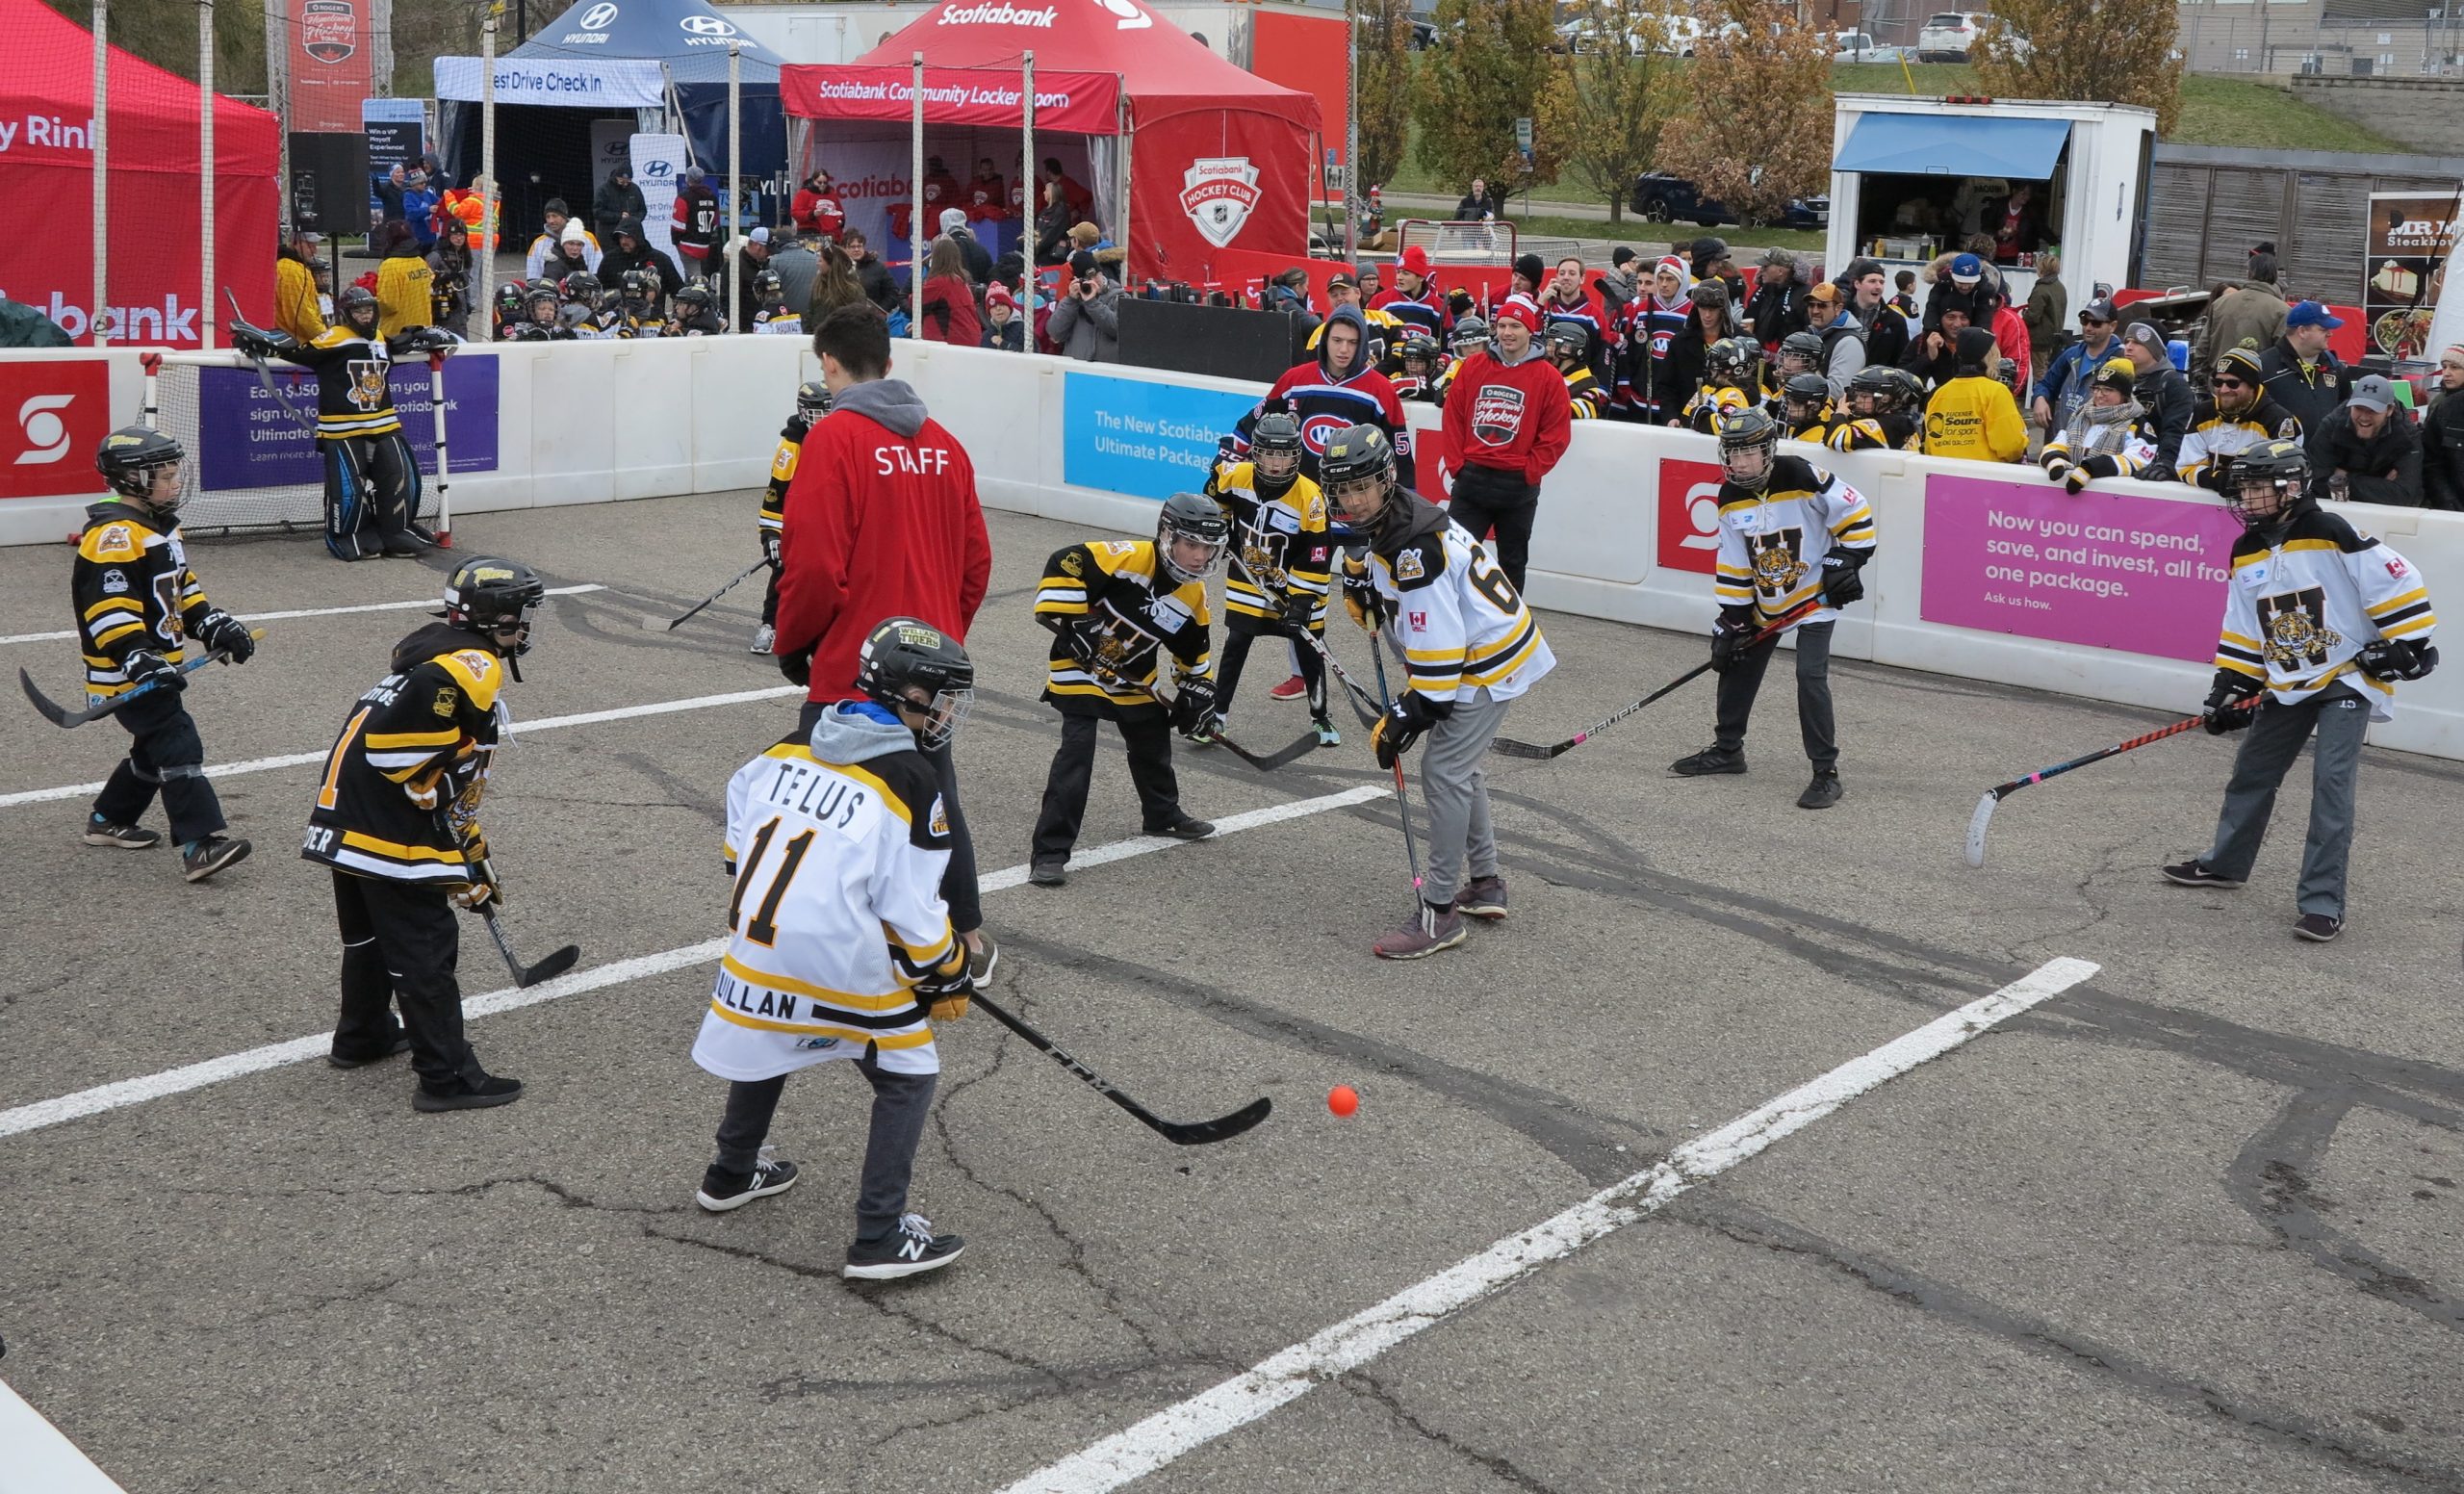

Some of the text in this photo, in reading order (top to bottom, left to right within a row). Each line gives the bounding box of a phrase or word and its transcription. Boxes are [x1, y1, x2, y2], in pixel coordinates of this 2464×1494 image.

[937, 2, 1059, 28] Scotiabank
[562, 33, 610, 44] HYUNDAI
[494, 71, 602, 92] est Drive Check In
[820, 81, 886, 100] Scotiabank
[971, 86, 1022, 106] Locker
[1032, 91, 1069, 108] oom
[1199, 165, 1243, 175] Scotiabank
[1188, 184, 1252, 206] HOCKEY CLUB
[250, 385, 282, 399] Ean
[404, 381, 429, 397] you
[1494, 390, 1517, 399] ROGERS
[250, 407, 280, 421] sign
[303, 405, 319, 418] fo
[392, 400, 459, 414] cotiabnk
[1476, 408, 1521, 430] Hockey
[250, 429, 310, 443] Ultimate
[1095, 410, 1224, 445] The New Scotiaba
[1095, 436, 1215, 474] Ultimate Packag
[1395, 432, 1409, 455] 5
[874, 446, 949, 476] STAFF
[1988, 509, 2205, 555] Now you can spend,
[1987, 539, 2231, 583] save, and invest, all fro
[1468, 544, 1521, 617] 6
[1986, 565, 2129, 598] one package.
[1984, 591, 2052, 610] Ask us how.
[900, 634, 939, 648] TIGERS
[1586, 702, 1639, 738] BAUER
[769, 764, 864, 830] TELUS
[729, 816, 817, 949] 11
[715, 972, 797, 1020] UILLAN
[1043, 1044, 1116, 1095] CCM
